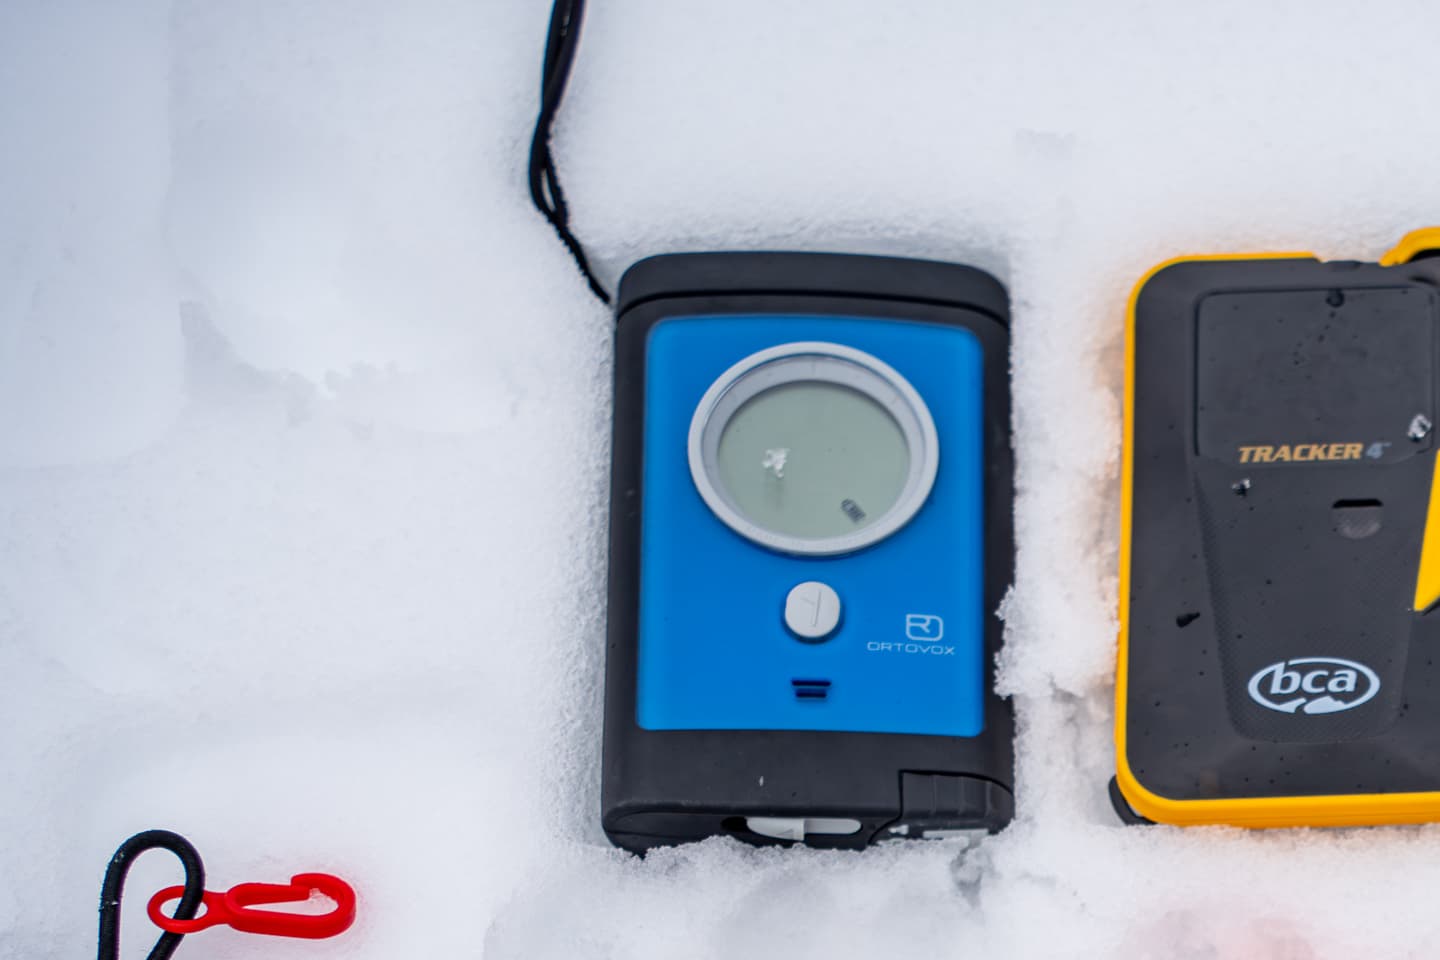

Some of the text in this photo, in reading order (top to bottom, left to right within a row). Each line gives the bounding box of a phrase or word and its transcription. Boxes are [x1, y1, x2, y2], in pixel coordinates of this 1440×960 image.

[1239, 442, 1364, 464] TRACKER
[866, 641, 955, 656] ORTOVOX
[1270, 661, 1358, 695] bca
